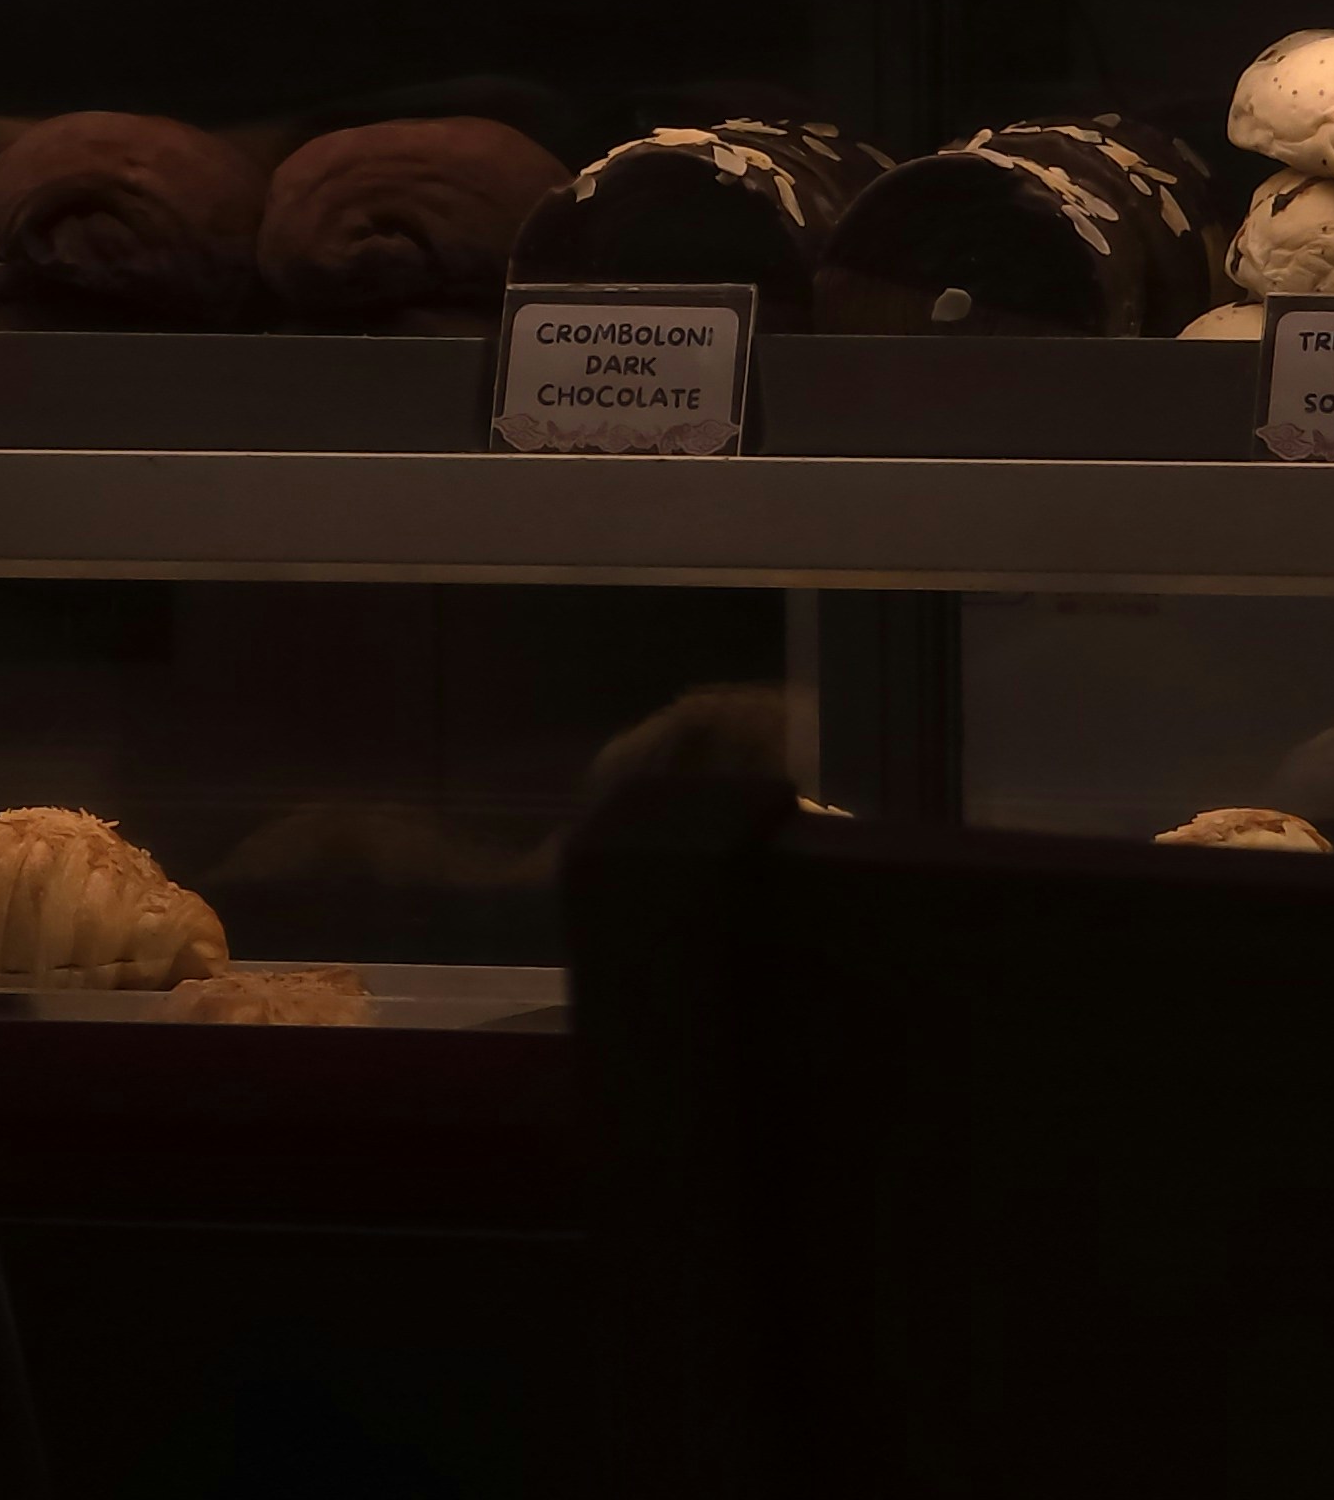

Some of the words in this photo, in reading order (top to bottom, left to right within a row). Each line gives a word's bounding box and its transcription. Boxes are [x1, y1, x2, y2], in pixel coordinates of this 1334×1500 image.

[536, 323, 713, 346] CROMBOLONI
[585, 355, 656, 376] DARK
[537, 384, 701, 409] CHOCOLATE
